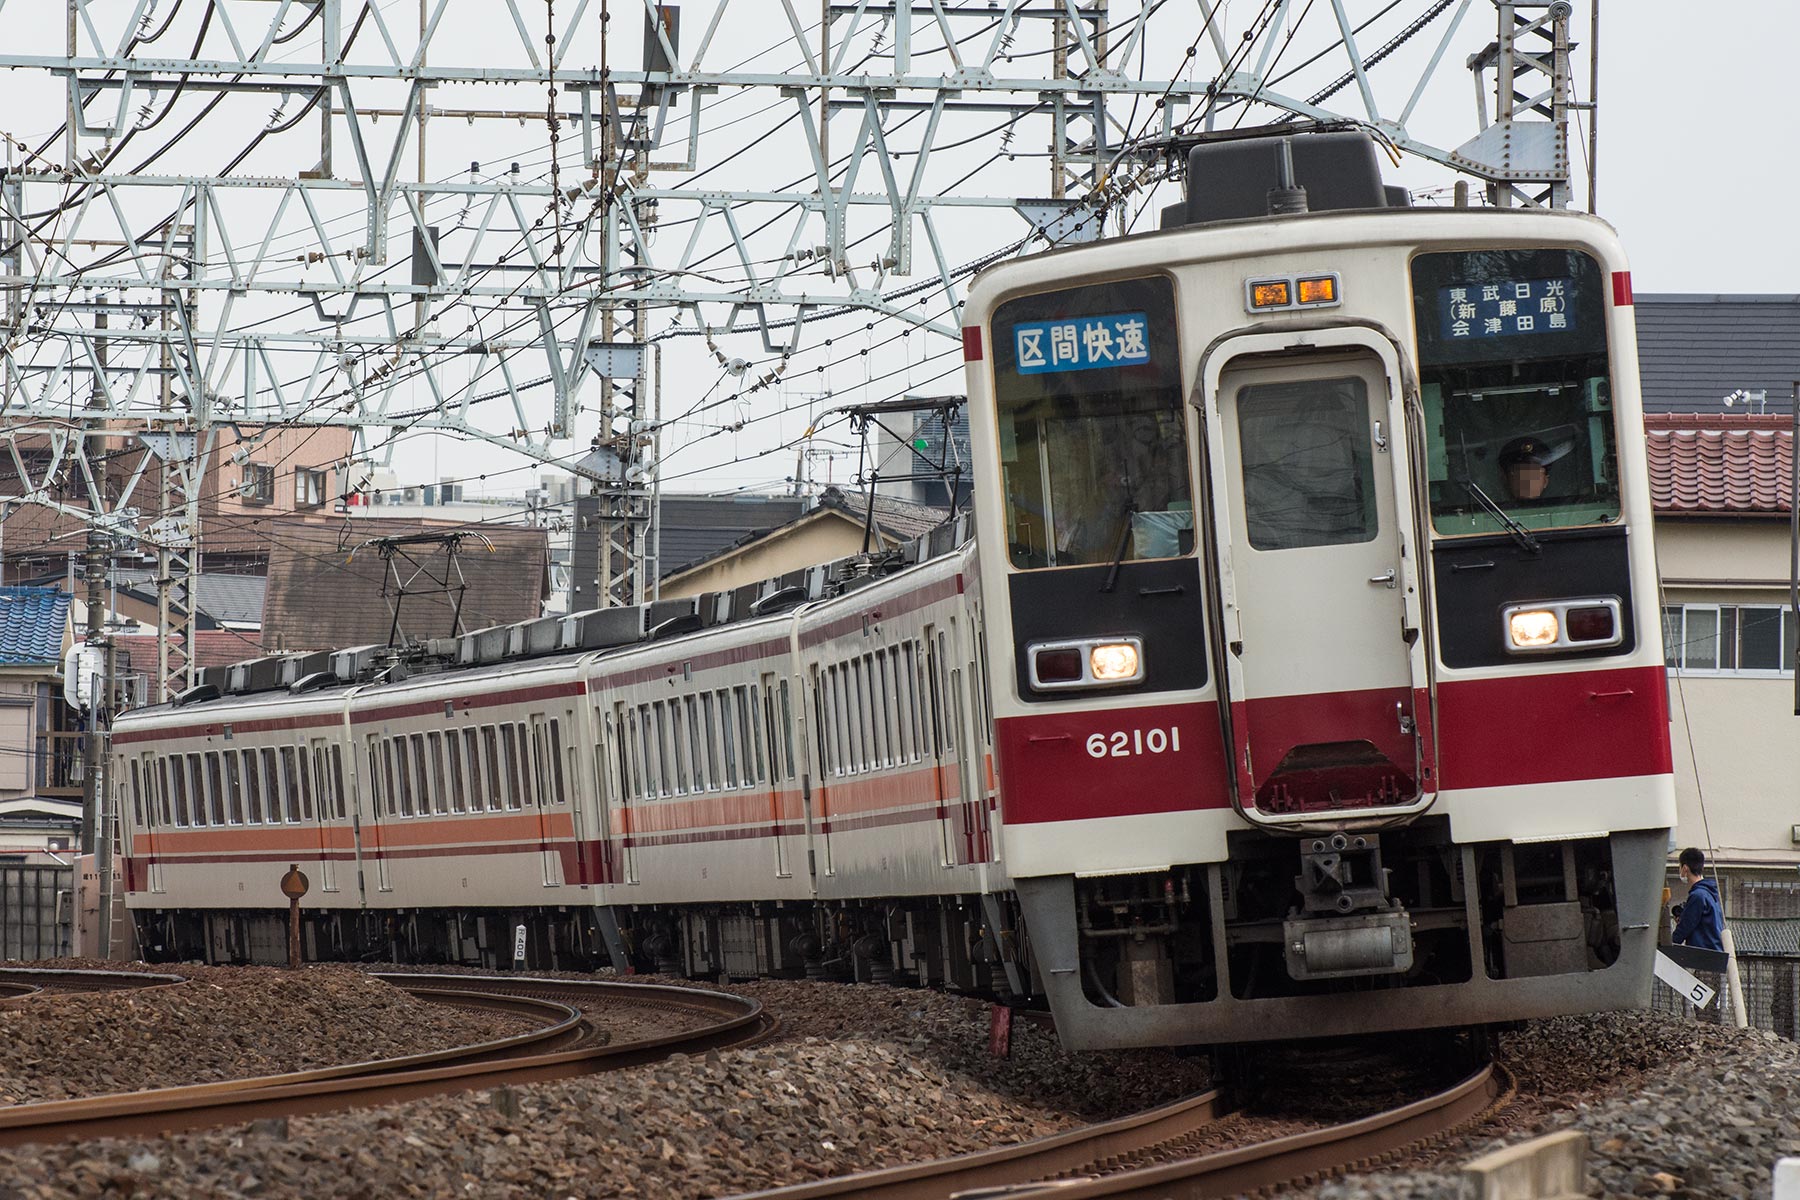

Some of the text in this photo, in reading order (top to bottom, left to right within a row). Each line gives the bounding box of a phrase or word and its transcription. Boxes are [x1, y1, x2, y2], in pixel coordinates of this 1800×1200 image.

[1449, 281, 1564, 303] 東武日光
[1450, 296, 1566, 321] (新藤原)
[1452, 313, 1567, 337] 会津田島
[1017, 319, 1147, 368] 区間快速
[1086, 726, 1180, 759] 62101
[1690, 984, 1708, 1002] 5
